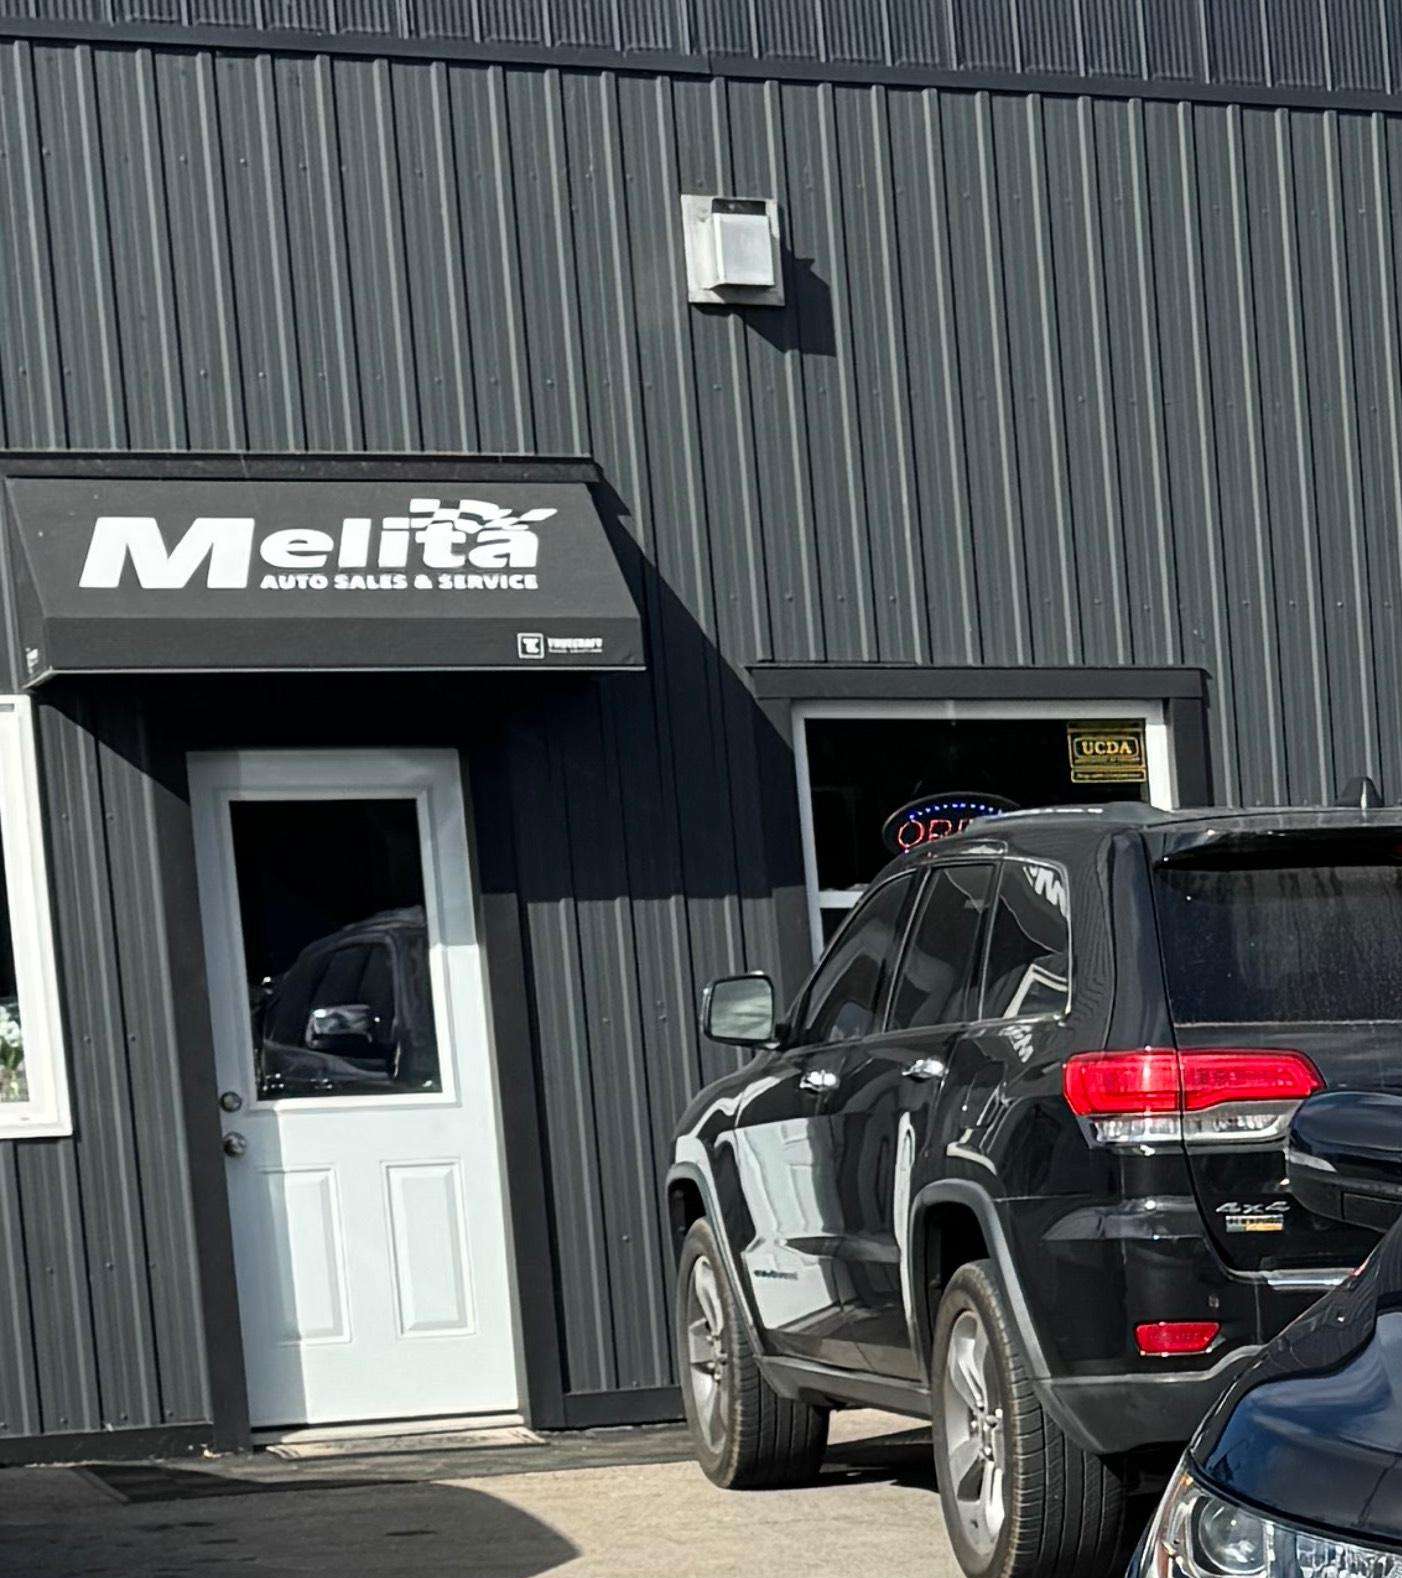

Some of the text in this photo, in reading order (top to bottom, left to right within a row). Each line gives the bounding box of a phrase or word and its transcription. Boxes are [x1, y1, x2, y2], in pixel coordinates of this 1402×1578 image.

[79, 514, 539, 589] Melita
[260, 573, 539, 590] AUTO SALES & SERVICE
[1081, 740, 1133, 755] UCDA
